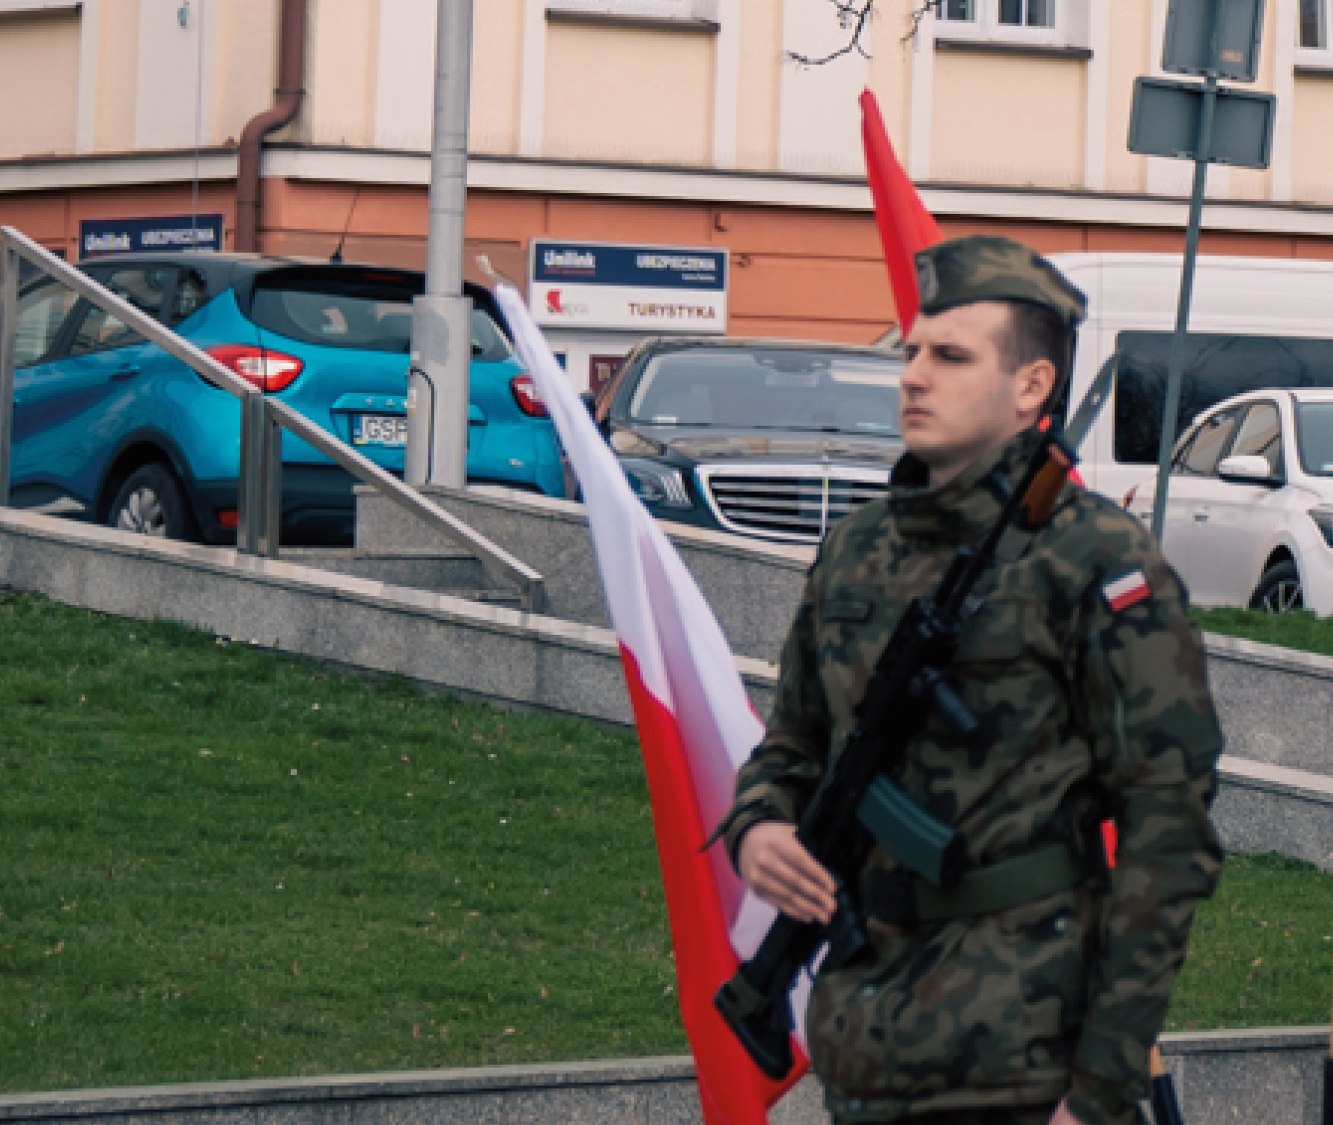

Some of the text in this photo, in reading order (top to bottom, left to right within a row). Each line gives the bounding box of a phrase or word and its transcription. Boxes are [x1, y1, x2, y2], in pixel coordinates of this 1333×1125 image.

[544, 249, 716, 271] Unilink UBEZPIECZENIA
[628, 302, 716, 319] TURYSTYKA
